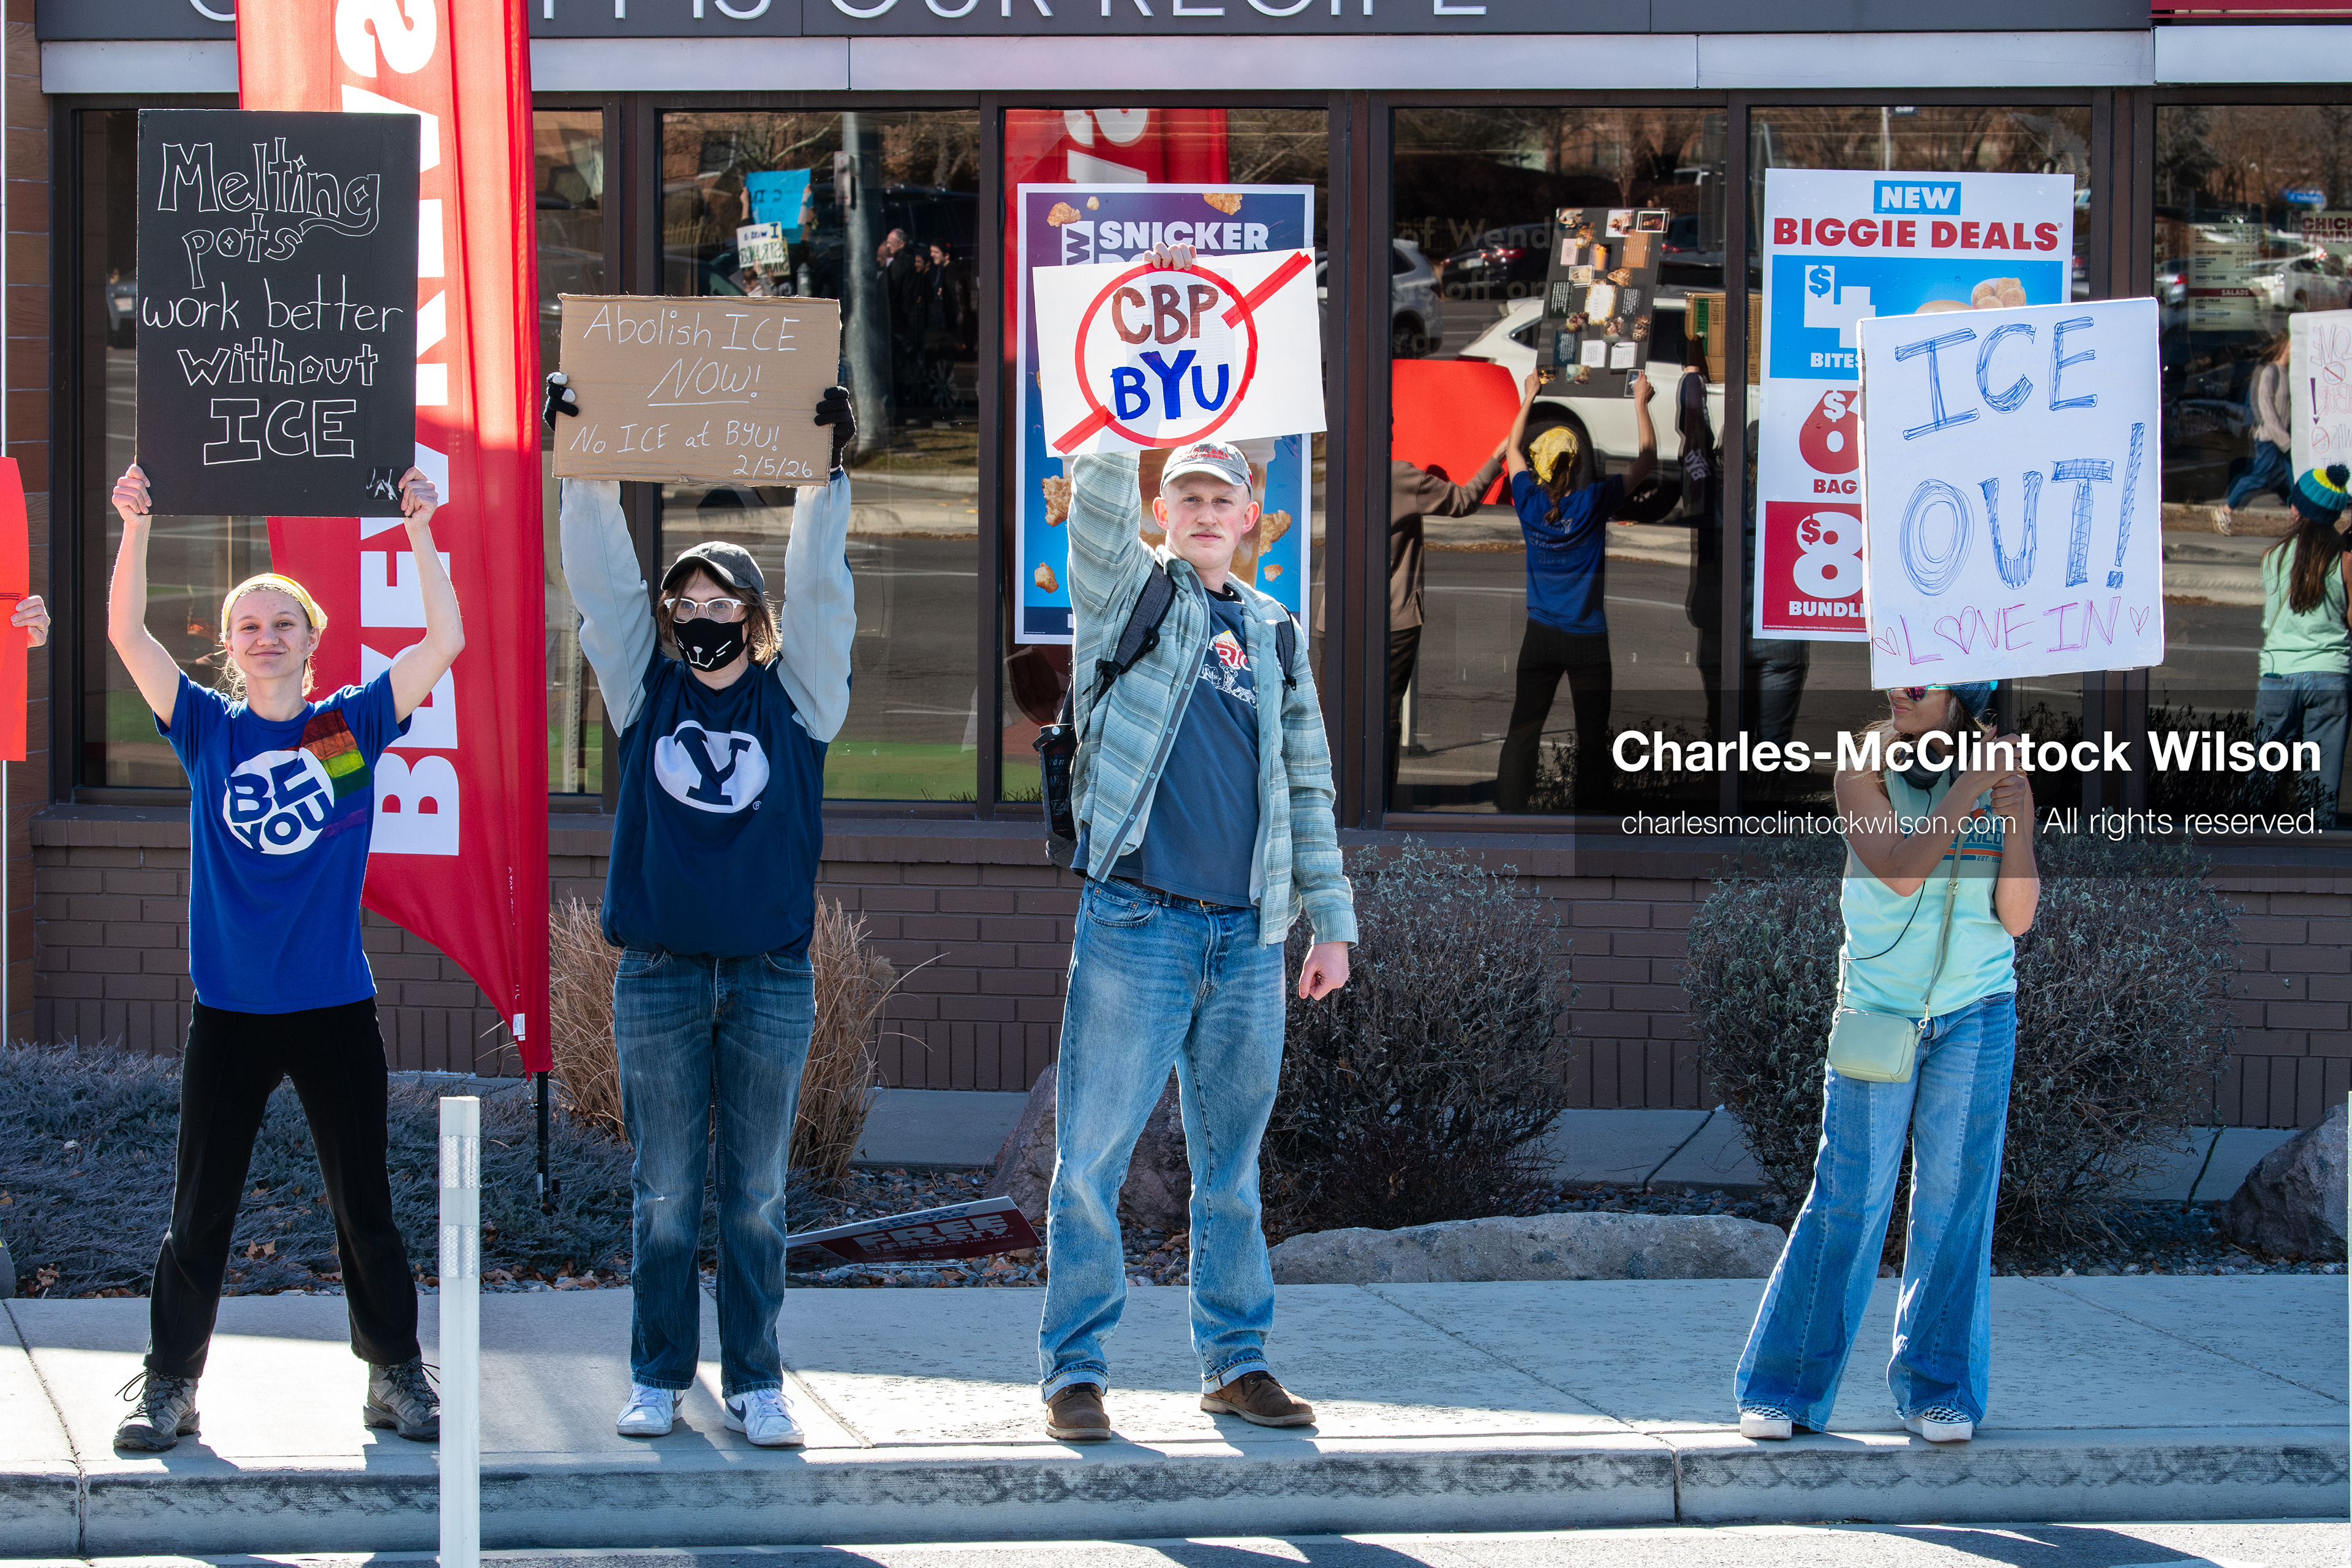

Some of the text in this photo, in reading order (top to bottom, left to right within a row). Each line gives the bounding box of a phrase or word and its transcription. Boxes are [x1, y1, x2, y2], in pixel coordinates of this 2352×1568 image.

[157, 137, 380, 236] Melting
[1881, 186, 1956, 209] NEW
[181, 213, 303, 289] pots
[1099, 221, 1269, 251] SNICKER
[1774, 217, 1916, 247] BIGGIE
[142, 274, 404, 332] work better
[1111, 284, 1219, 344] CBP
[583, 304, 801, 351] Abolish ICE
[176, 336, 378, 386] without
[647, 357, 761, 398] NOW!
[1894, 316, 2098, 441] ICE
[1110, 349, 1229, 420] BYU
[203, 398, 356, 466] ICE
[570, 420, 780, 453] No ICE at BYU!
[733, 455, 813, 480] 2/5/26
[1813, 479, 1858, 494] BAG
[1899, 423, 2145, 597] OUT!
[232, 790, 334, 851] YOU
[853, 1214, 1009, 1246] FREE
[888, 1206, 970, 1223] FROSTY
[881, 1227, 1011, 1249] FROSTY
[912, 1241, 962, 1250] PURCHASE
